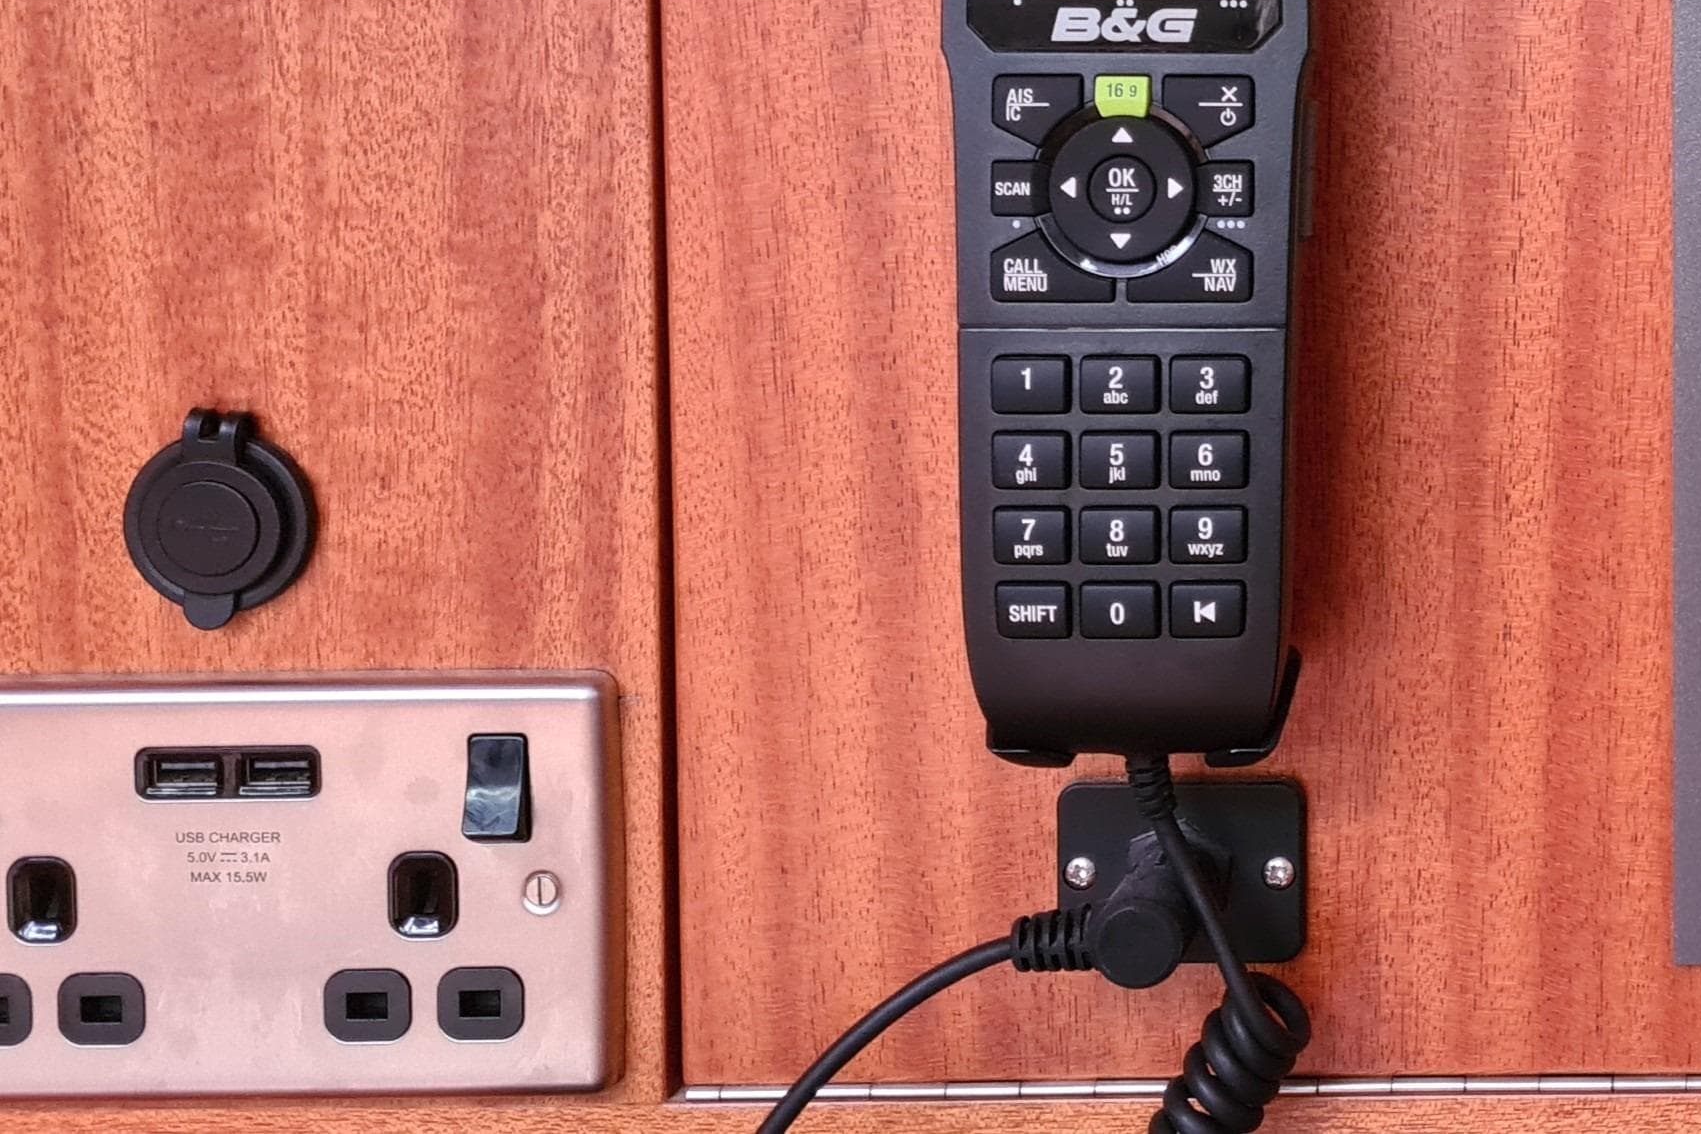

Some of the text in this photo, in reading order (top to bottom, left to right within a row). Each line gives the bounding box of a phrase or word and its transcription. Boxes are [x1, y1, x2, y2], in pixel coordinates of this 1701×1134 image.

[1051, 7, 1198, 43] B&G
[1006, 89, 1033, 104] AIS
[1106, 83, 1138, 97] 16 9
[1006, 107, 1021, 121] IC
[1108, 168, 1136, 187] OK
[1213, 175, 1242, 189] 3CH
[995, 182, 1030, 196] SCAN
[1111, 193, 1132, 206] H/L
[1004, 259, 1042, 274] CALL
[1211, 259, 1236, 273] WX
[1003, 276, 1047, 291] MENU
[1204, 276, 1236, 291] NAV
[1021, 368, 1031, 390] 1
[1108, 366, 1123, 389] 2
[1200, 367, 1214, 389] 3
[1103, 390, 1128, 405] abc
[1195, 390, 1218, 405] def
[1018, 444, 1033, 466] 4
[1109, 444, 1124, 466] 5
[1198, 444, 1213, 466] 6
[1015, 467, 1037, 484] ghi
[1109, 467, 1126, 484] jkl
[1190, 470, 1221, 481] mno
[1021, 519, 1035, 541] 7
[1109, 519, 1124, 542] 8
[1198, 517, 1213, 539] 9
[1014, 543, 1043, 559] pqrs
[1106, 542, 1128, 557] tuv
[1188, 542, 1224, 558] wxyz
[1009, 605, 1057, 623] SHIFT
[1110, 602, 1125, 625] 0
[176, 832, 281, 843] USB CHARGER
[187, 852, 270, 863] 5.0V 3.1A
[190, 872, 267, 882] MAX 15.5W
